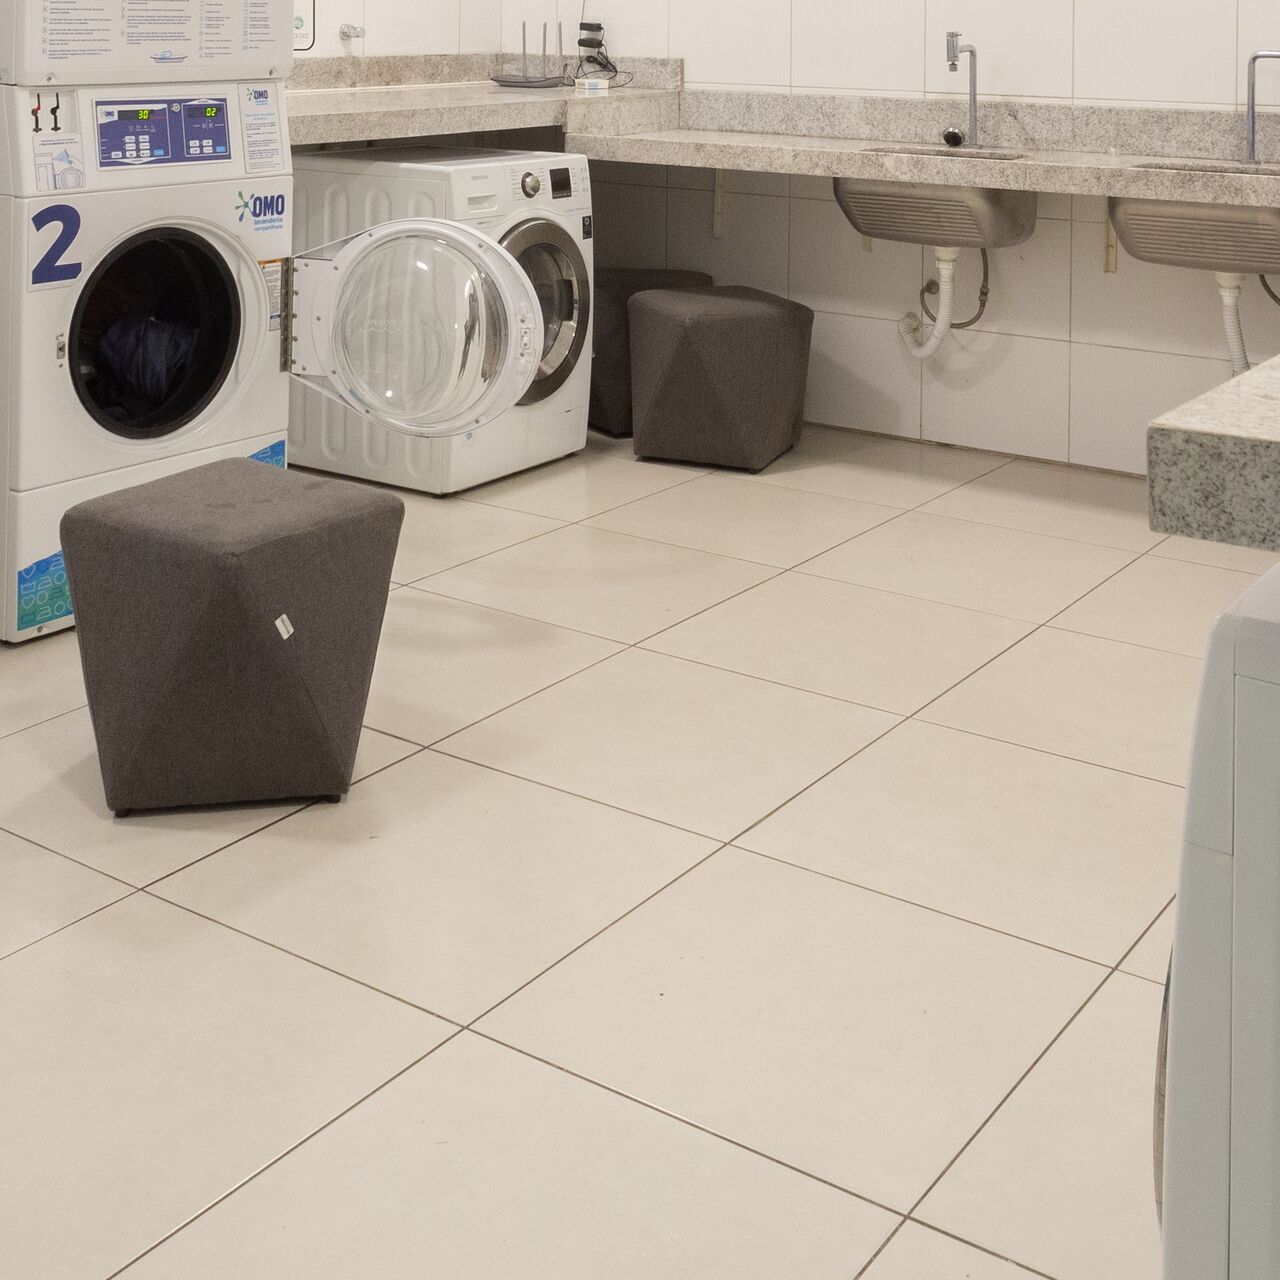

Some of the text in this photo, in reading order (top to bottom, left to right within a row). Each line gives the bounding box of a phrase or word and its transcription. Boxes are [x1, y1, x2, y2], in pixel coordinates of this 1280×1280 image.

[253, 89, 269, 100] OMO
[138, 110, 149, 119] 30
[206, 107, 216, 116] 02
[252, 194, 285, 218] OMO
[31, 204, 82, 285] 2
